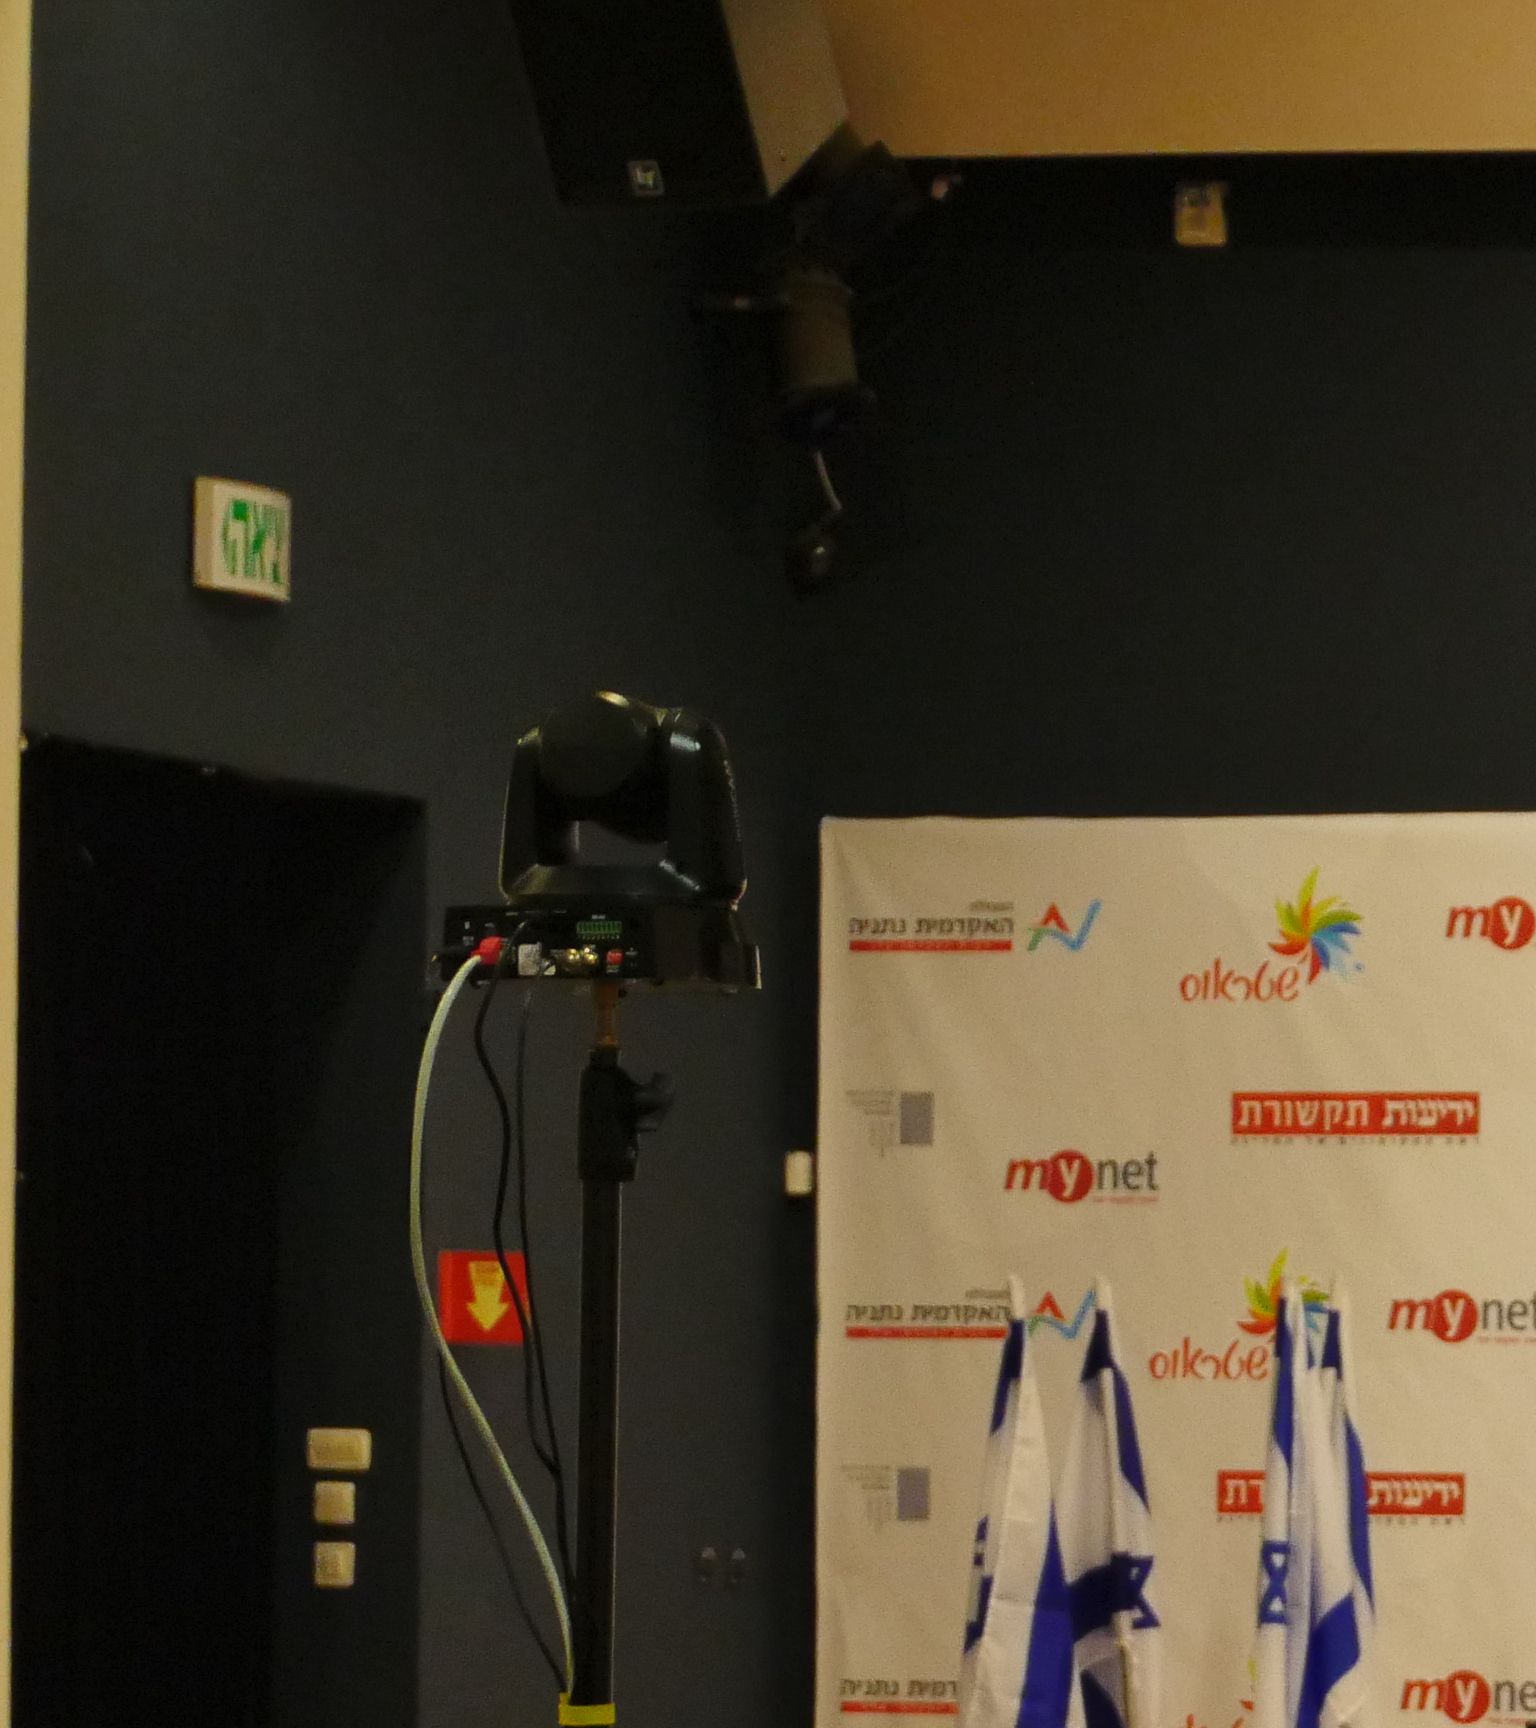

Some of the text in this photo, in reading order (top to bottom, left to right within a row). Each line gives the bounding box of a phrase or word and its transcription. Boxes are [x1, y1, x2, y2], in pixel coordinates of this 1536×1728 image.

[1179, 957, 1300, 1002] שטראוס
[1238, 1098, 1475, 1131] ידיעות תקשורת
[1003, 1149, 1159, 1204] mynet
[1149, 1336, 1269, 1380] שטראוס
